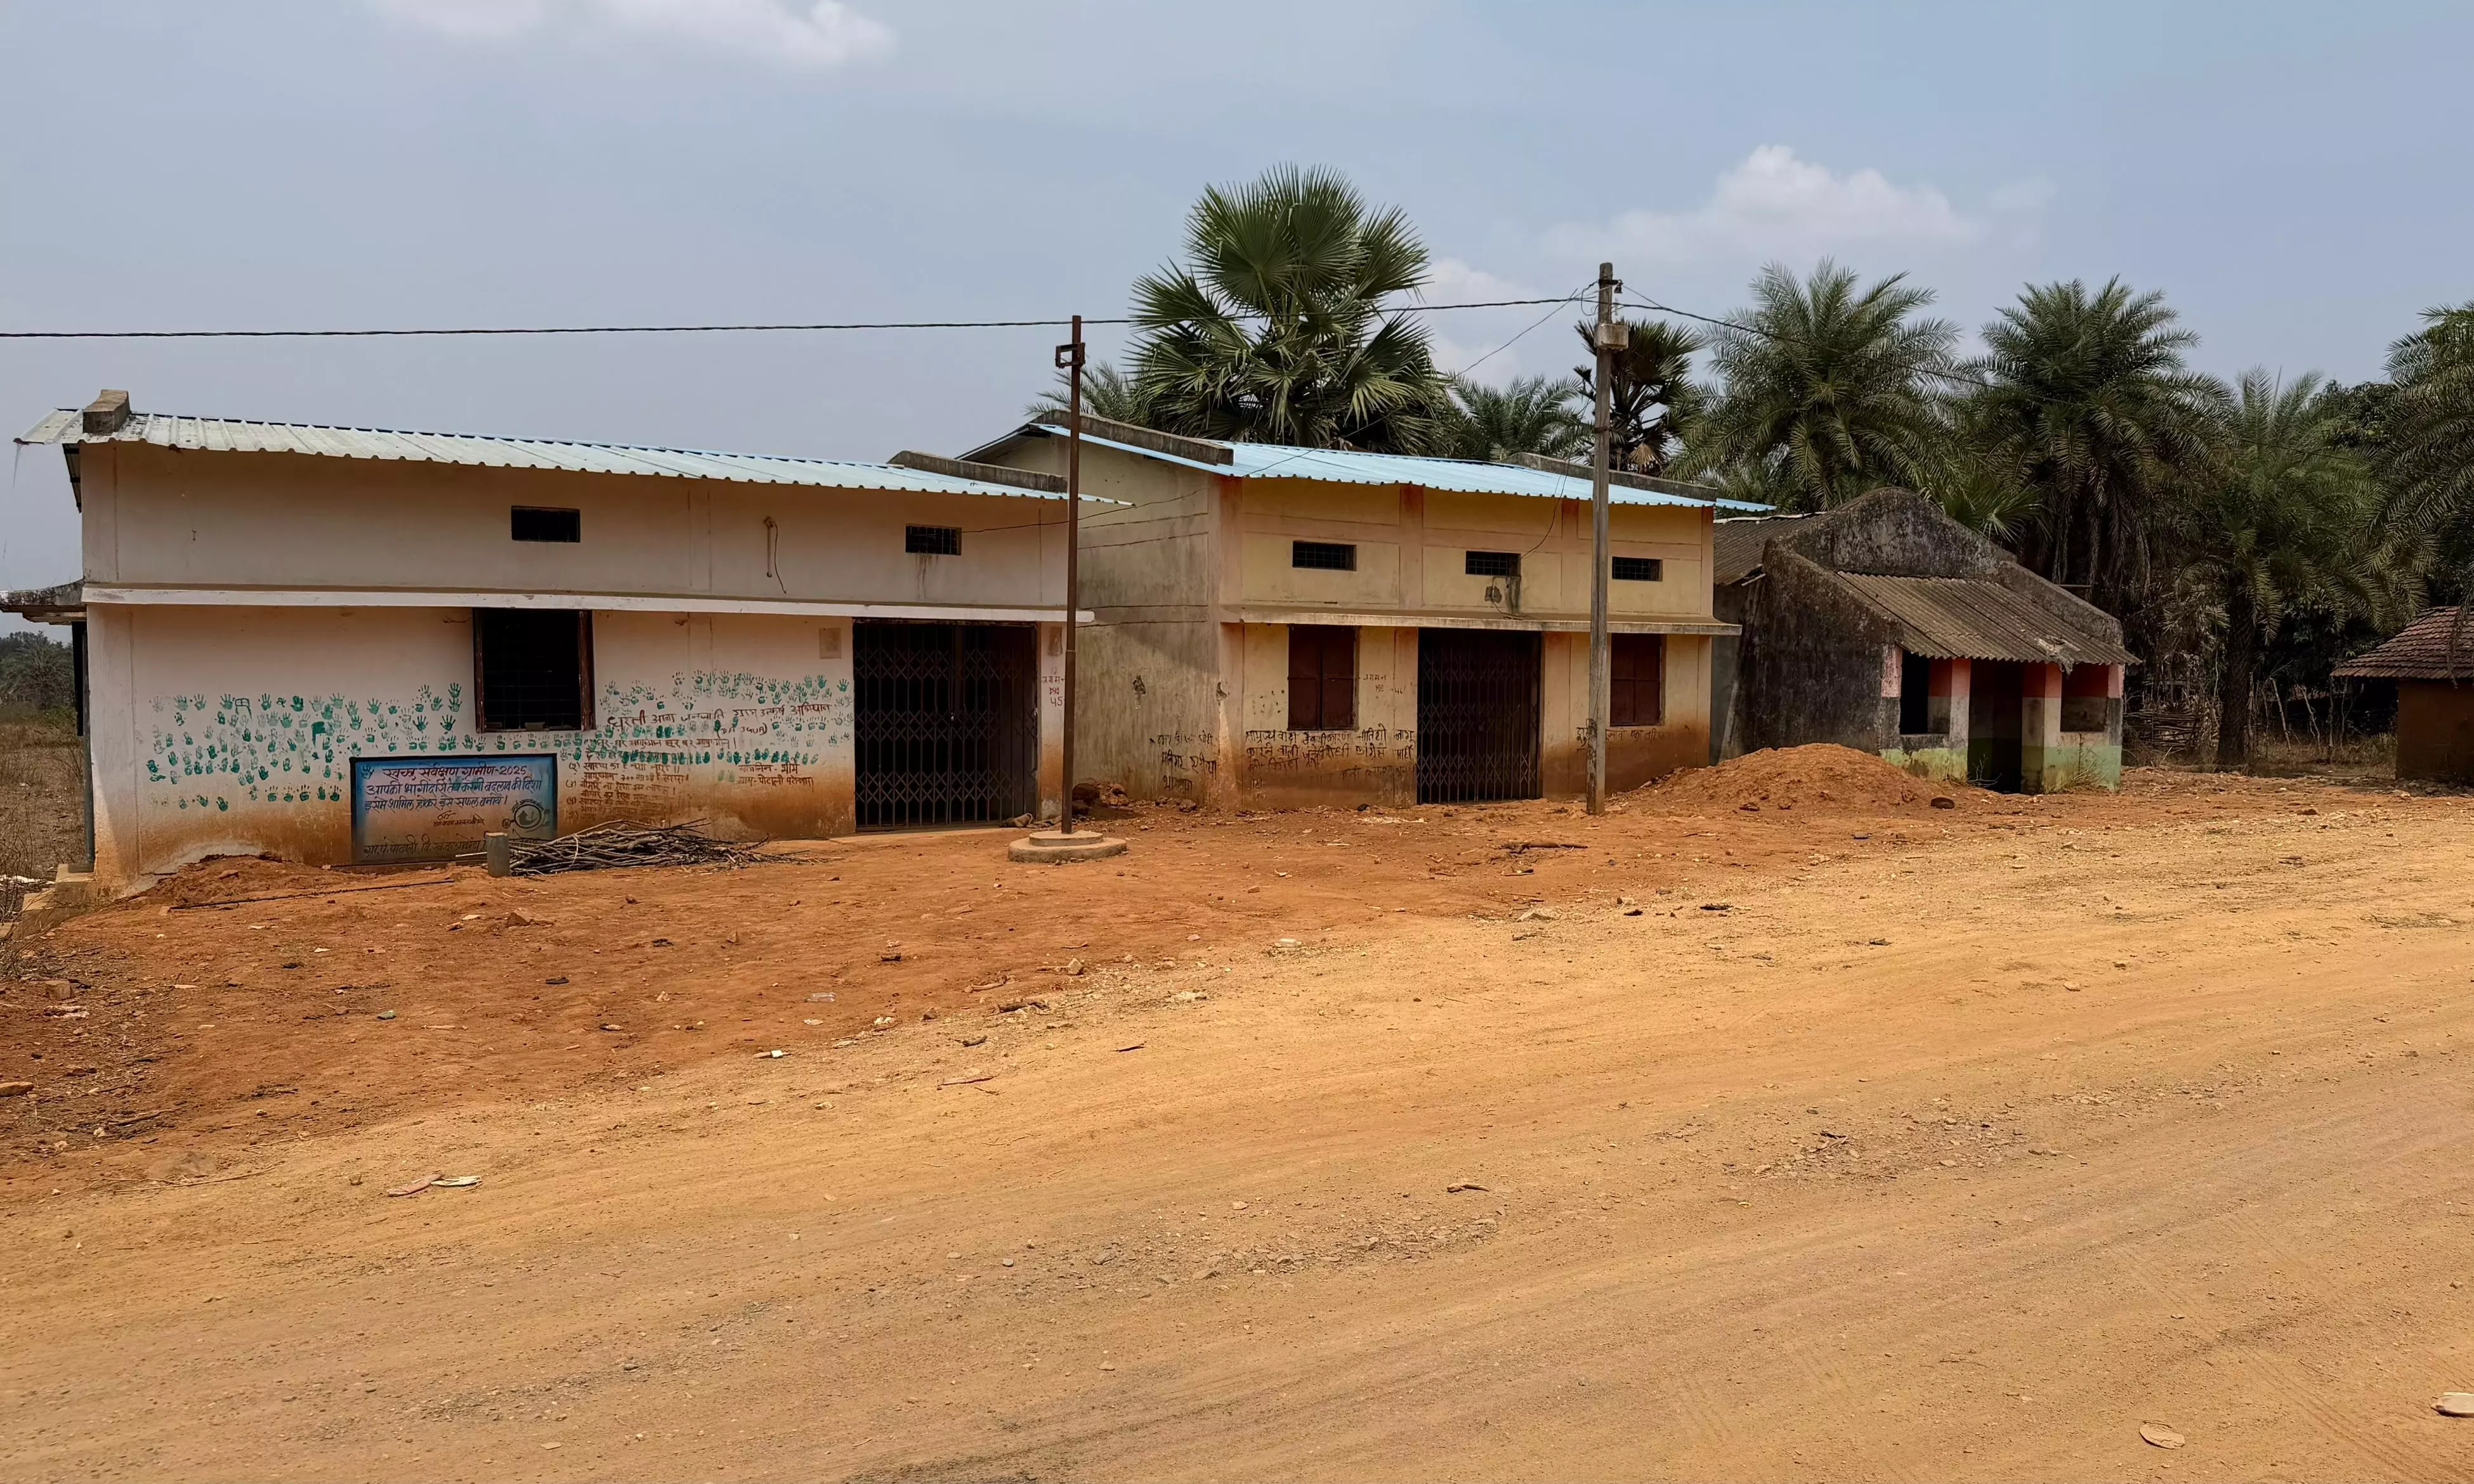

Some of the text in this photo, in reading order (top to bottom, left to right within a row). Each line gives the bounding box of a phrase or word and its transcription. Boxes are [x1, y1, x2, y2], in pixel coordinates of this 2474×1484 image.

[365, 780, 403, 795] आपकी
[404, 778, 447, 797] भागीदारी
[511, 777, 521, 790] की
